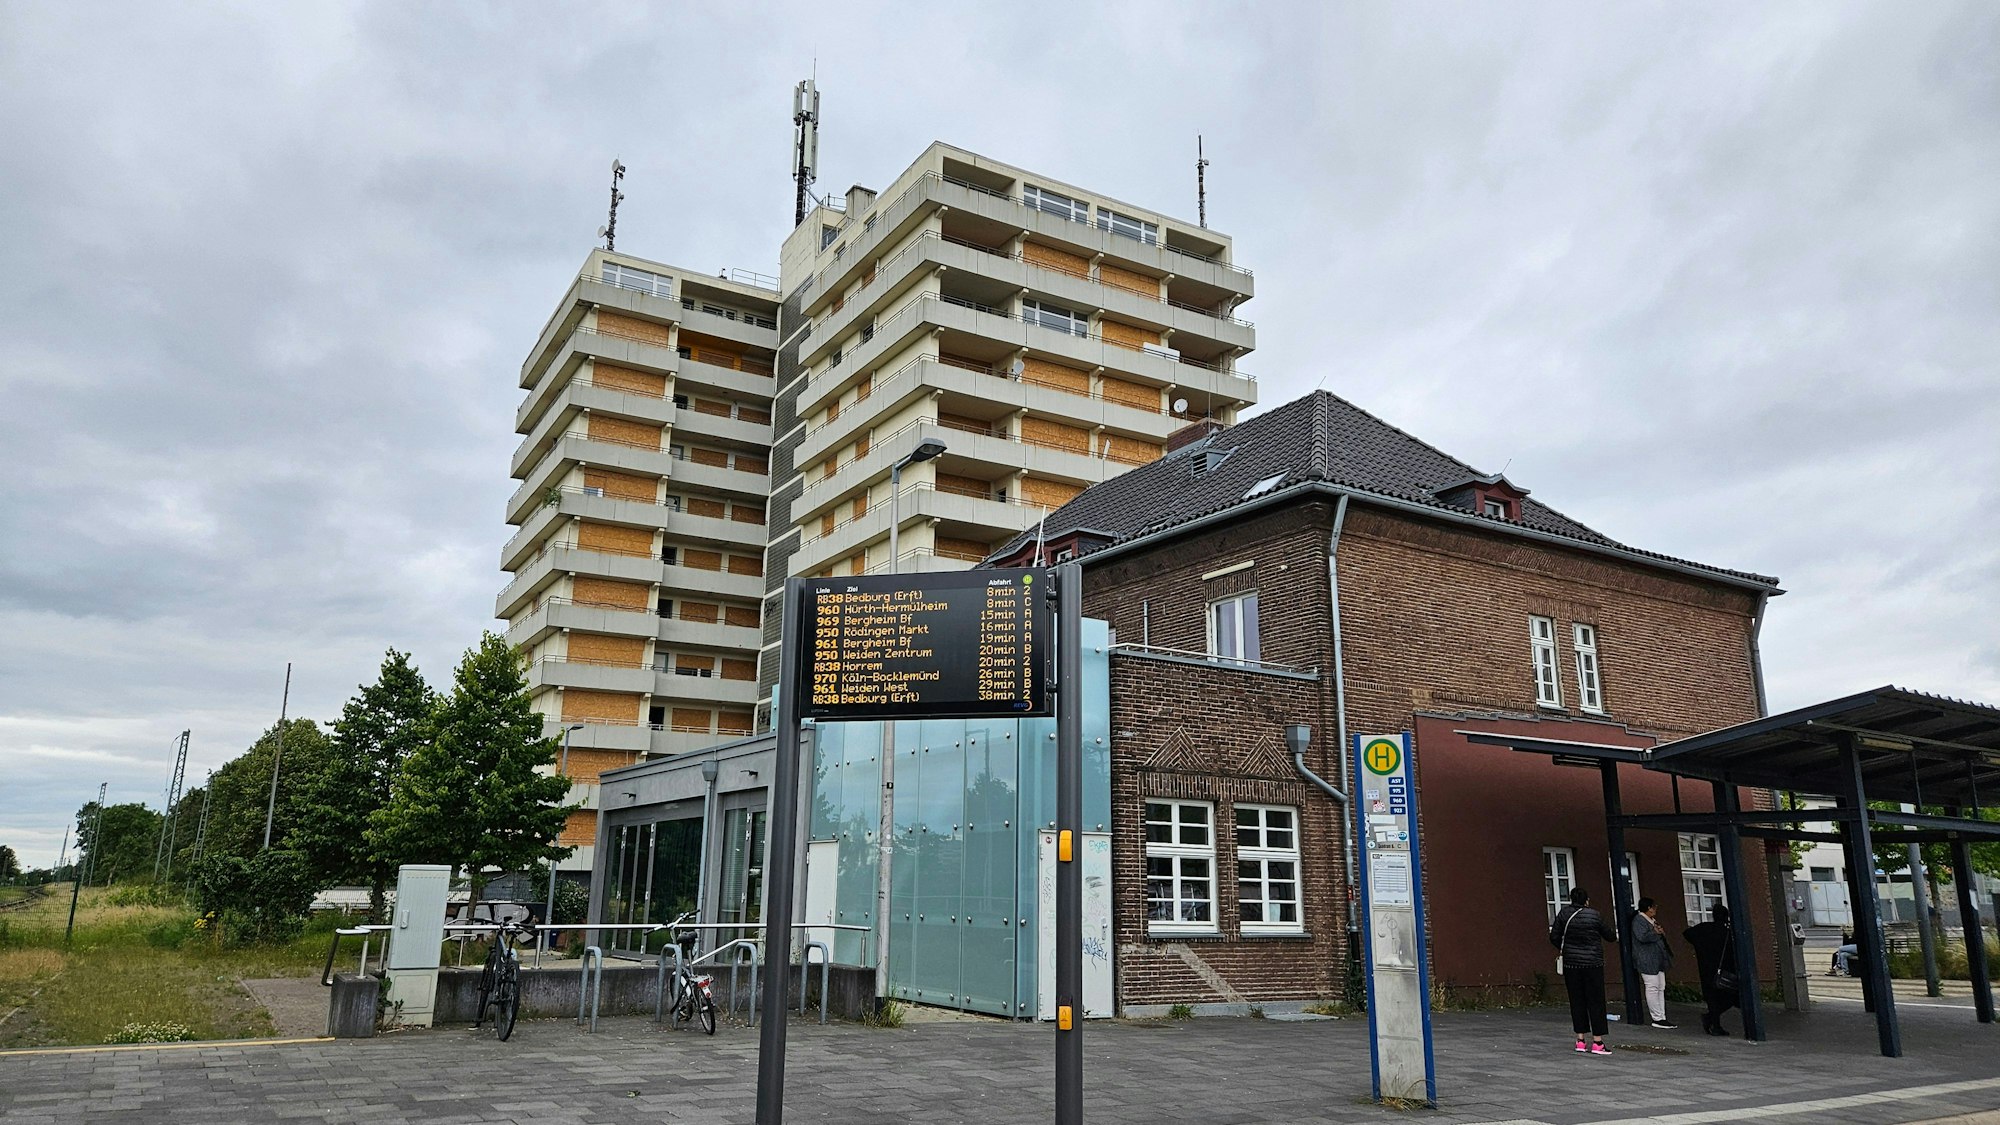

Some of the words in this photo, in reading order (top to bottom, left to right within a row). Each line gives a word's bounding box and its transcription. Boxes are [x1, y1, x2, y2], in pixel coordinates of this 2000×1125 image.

[818, 594, 843, 604] RB38
[846, 593, 890, 603] Bedburg
[895, 590, 923, 600] (Erft)
[987, 587, 1015, 596] 8min
[1024, 586, 1030, 595] 2
[817, 606, 839, 614] 960
[844, 602, 948, 614] Hürth-Hermülheim
[987, 599, 1015, 608] 8min
[1024, 598, 1032, 606] C
[817, 617, 839, 626] 969
[844, 615, 896, 626] Bergheim
[900, 614, 912, 624] Bf
[981, 610, 1015, 620] 15min
[1024, 610, 1032, 618] A
[816, 628, 839, 637] 950
[844, 626, 894, 637] Rödingen
[899, 625, 929, 634] Markt
[980, 622, 1015, 632] 16min
[1024, 621, 1032, 630] A
[816, 639, 838, 649] 961
[843, 637, 896, 649] Bergheim
[900, 637, 912, 648] Bf
[980, 634, 1015, 643] 19min
[1024, 633, 1032, 641] A
[815, 651, 838, 660] 950
[843, 649, 880, 660] Weiden
[885, 648, 932, 658] Zentrum
[979, 645, 1015, 655] 20min
[1024, 645, 1032, 653] B
[814, 662, 840, 671] RB38
[843, 662, 882, 671] Horrem
[979, 657, 1015, 667] 20min
[1023, 656, 1030, 665] 2
[814, 674, 837, 683] 970
[842, 671, 939, 682] Köln-Bocklemünd
[979, 669, 1015, 679] 26min
[1024, 669, 1032, 677] B
[813, 685, 836, 694] 961
[842, 683, 879, 693] Weiden
[884, 682, 908, 691] West
[978, 680, 1015, 690] 29min
[1024, 679, 1032, 688] B
[813, 695, 839, 704] RB38
[841, 694, 887, 704] Bedburg
[891, 692, 920, 702] (Erft)
[979, 691, 1015, 700] 38min
[1023, 691, 1030, 699] 2
[1375, 747, 1389, 767] H
